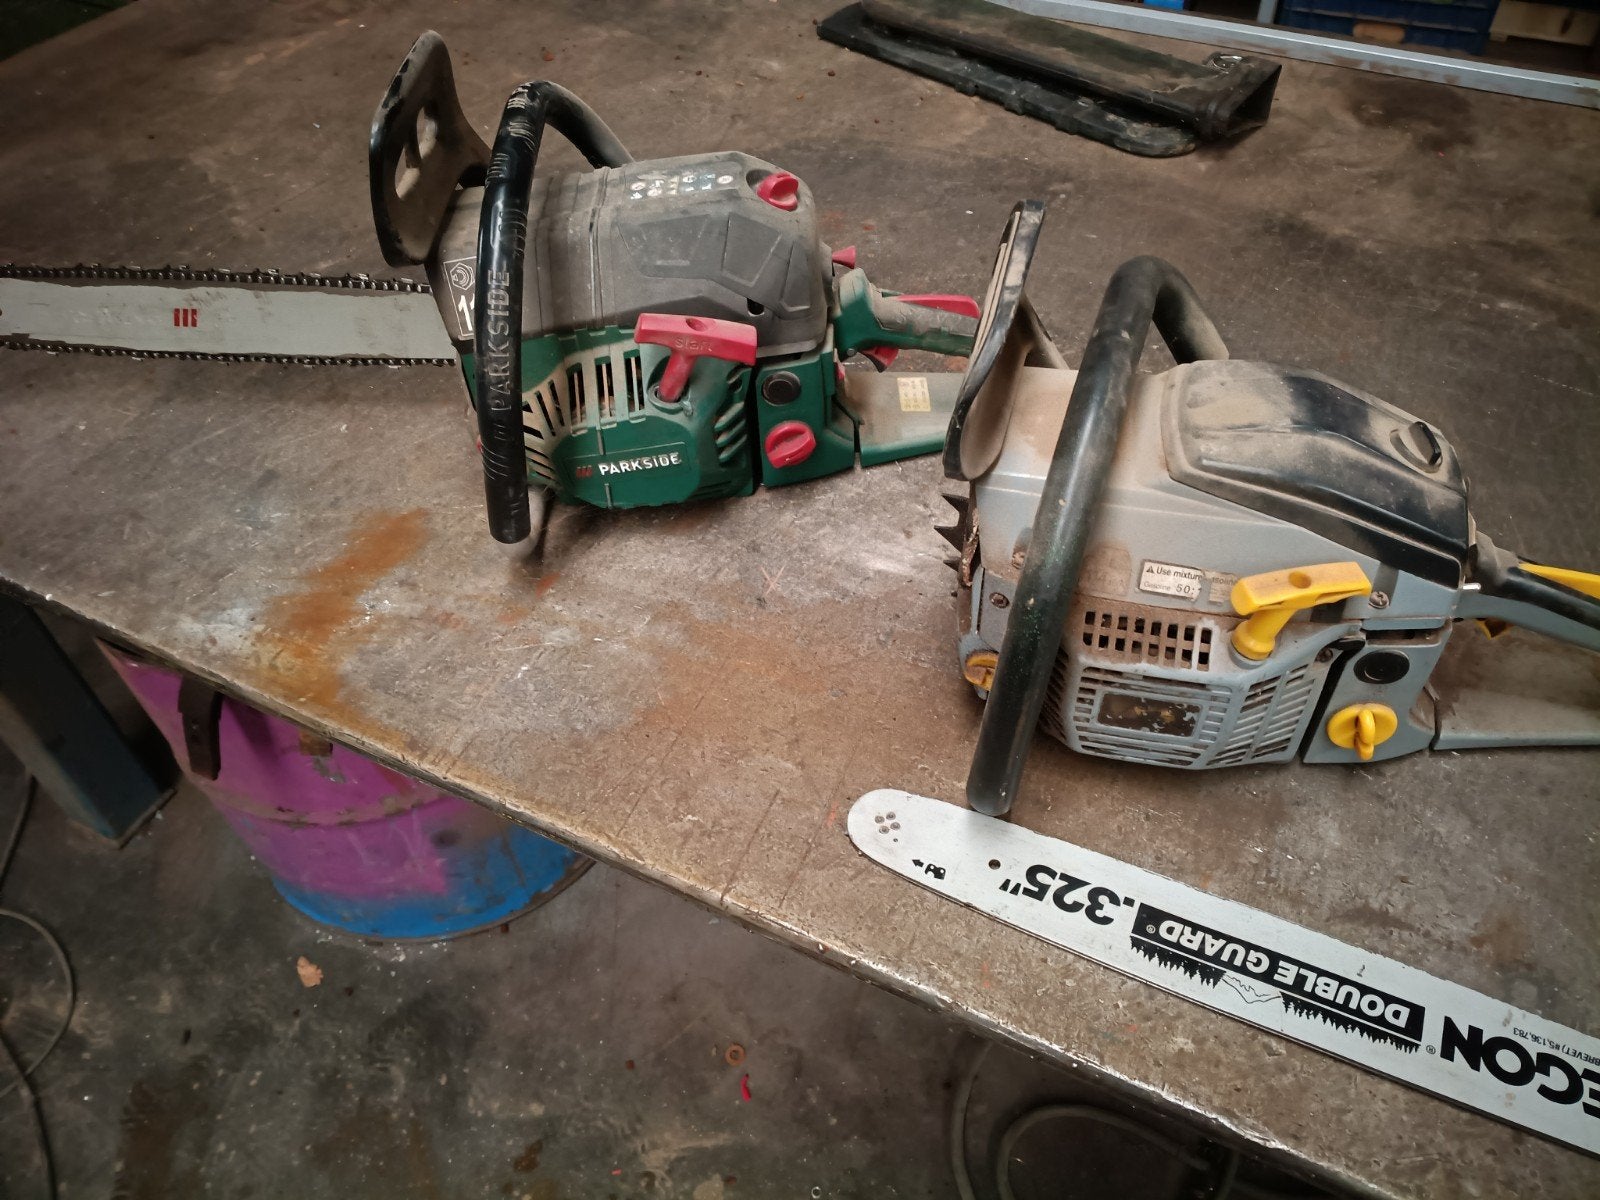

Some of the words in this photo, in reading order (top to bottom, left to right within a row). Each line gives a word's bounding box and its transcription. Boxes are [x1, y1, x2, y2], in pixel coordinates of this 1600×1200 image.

[487, 269, 512, 412] PARKSIDE
[598, 452, 682, 476] PARKSIDE
[1156, 565, 1172, 576] Use
[1158, 920, 1270, 974] GUARD
[1274, 960, 1410, 1028] DOUBLE
